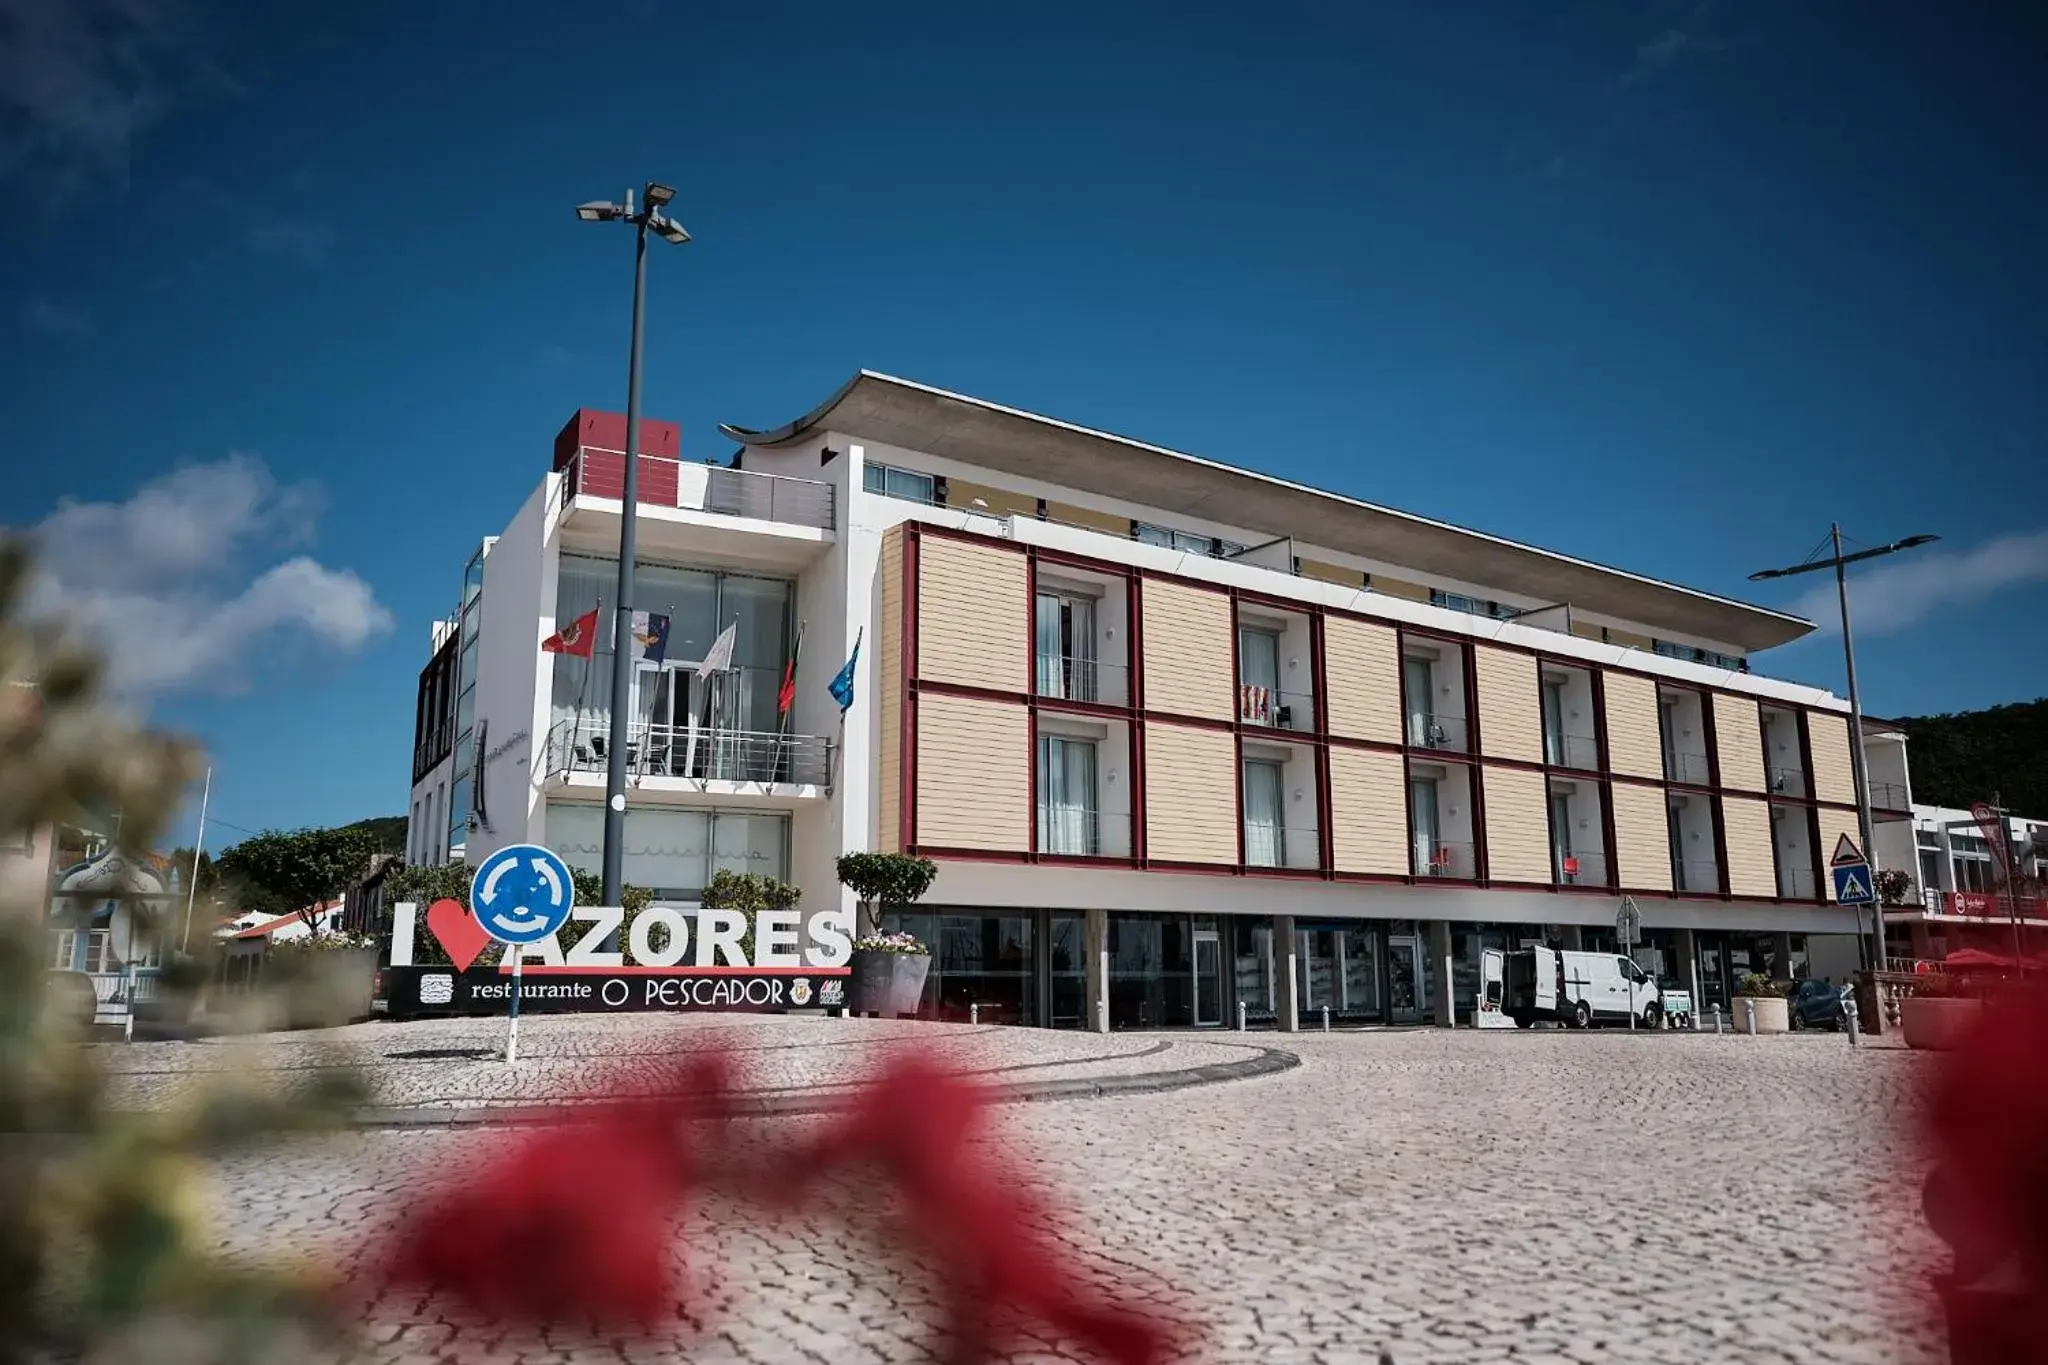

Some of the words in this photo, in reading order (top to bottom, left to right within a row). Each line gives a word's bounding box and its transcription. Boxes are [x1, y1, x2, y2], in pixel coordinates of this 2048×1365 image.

[390, 902, 415, 967] I
[471, 982, 593, 999] resturante
[602, 978, 630, 1006] O
[645, 978, 784, 1006] PESCADOR
